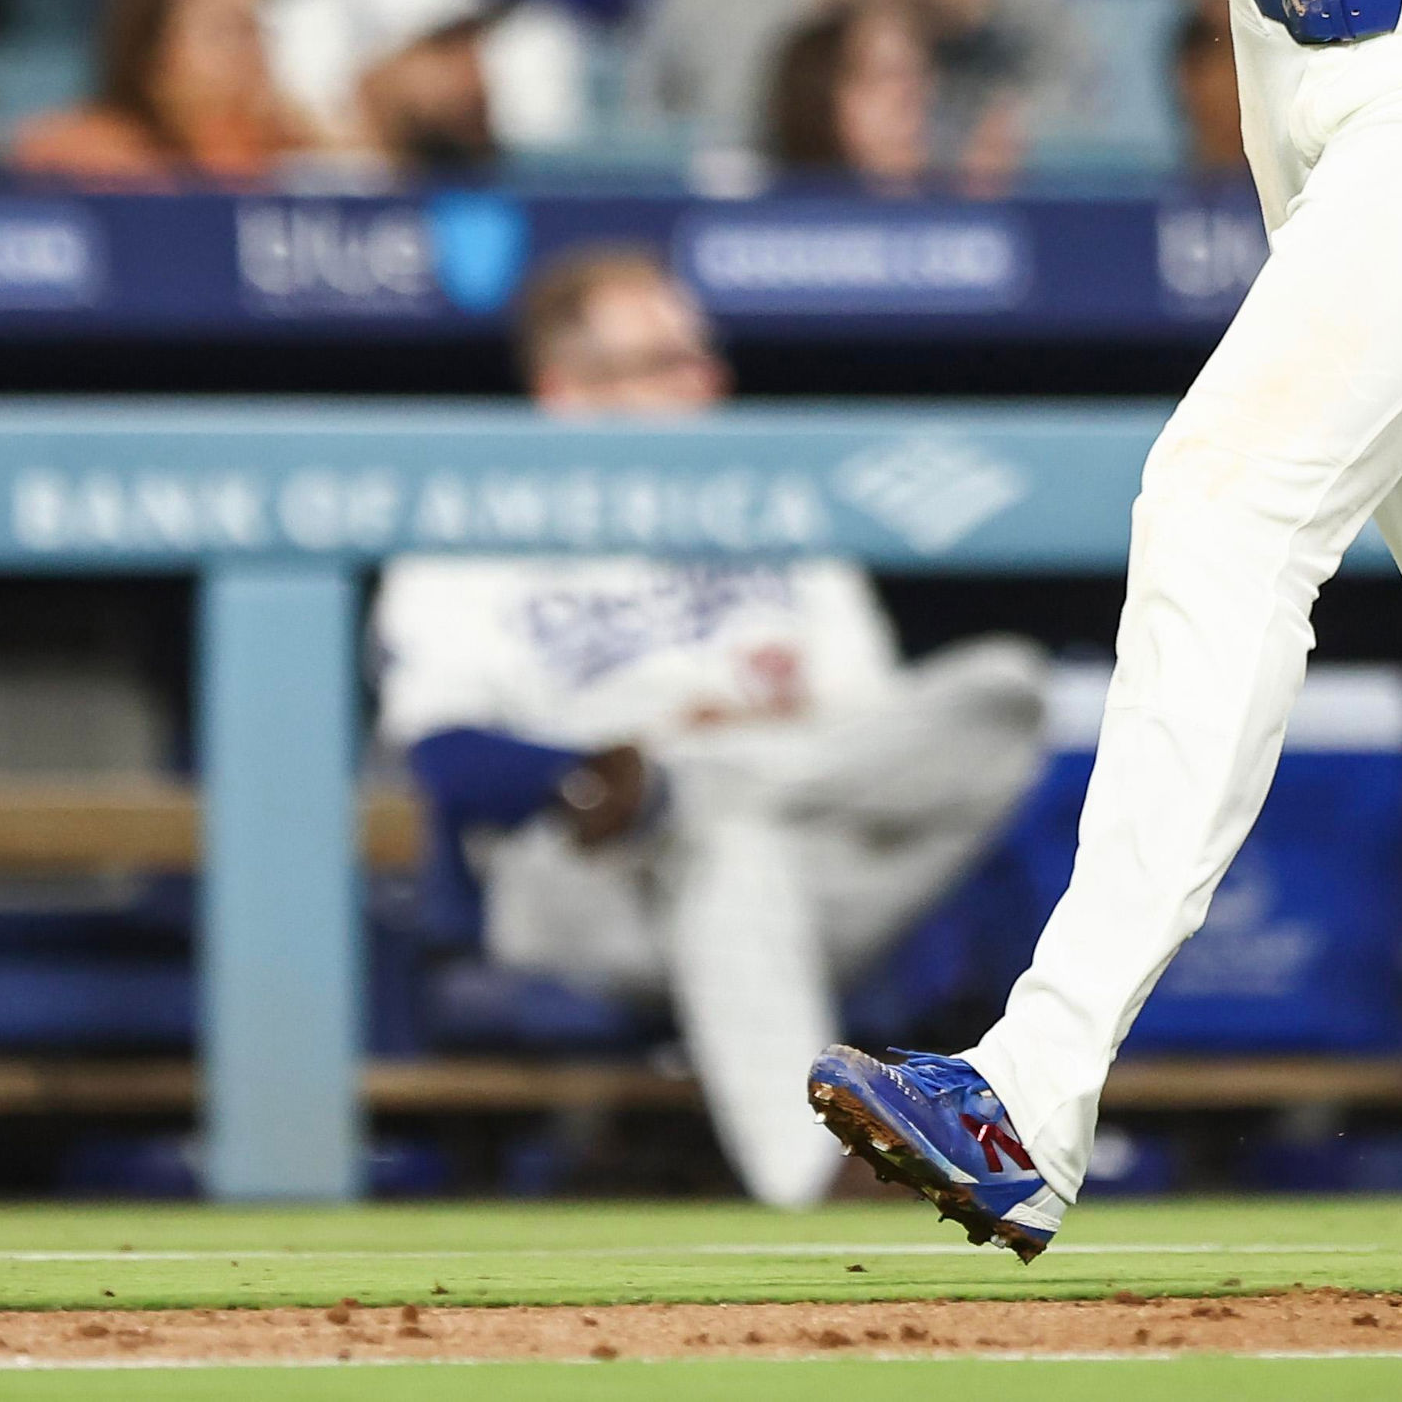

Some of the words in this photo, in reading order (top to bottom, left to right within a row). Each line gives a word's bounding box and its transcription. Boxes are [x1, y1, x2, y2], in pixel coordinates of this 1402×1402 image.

[238, 201, 434, 295] blue
[12, 468, 268, 552] BANK
[277, 468, 395, 552] OF
[414, 467, 833, 552] AMERICA
